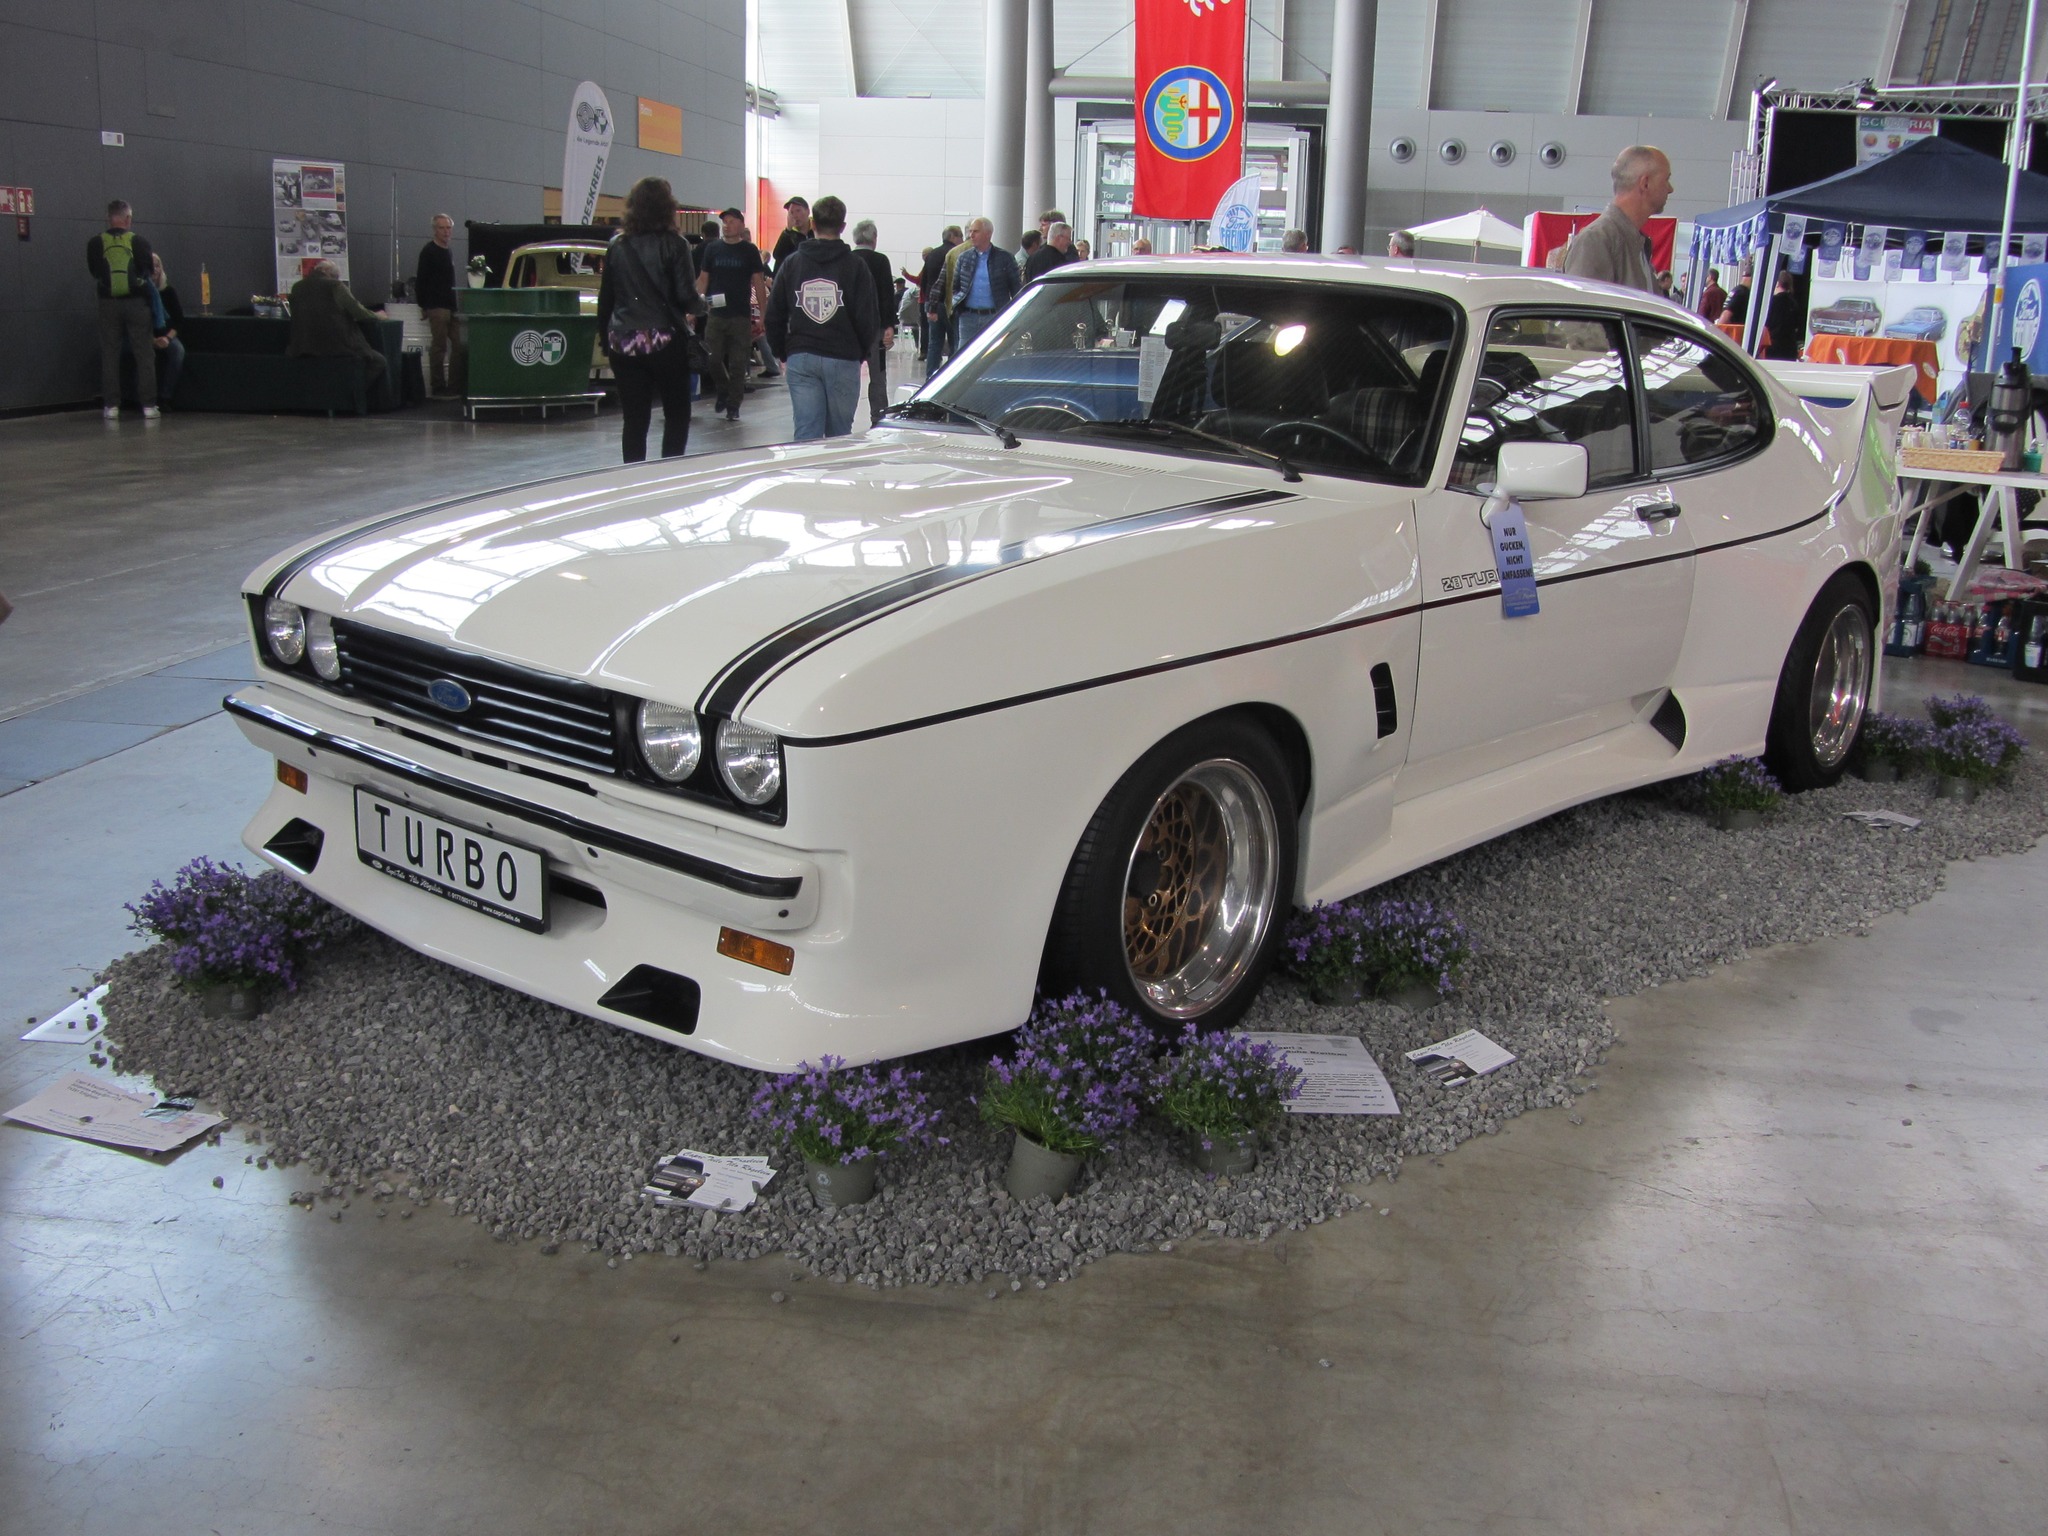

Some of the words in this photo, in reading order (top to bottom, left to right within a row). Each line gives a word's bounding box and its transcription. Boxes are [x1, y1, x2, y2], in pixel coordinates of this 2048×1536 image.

[1101, 191, 1114, 199] Tor
[1226, 216, 1250, 230] Ford
[1503, 527, 1517, 537] NUR
[1500, 540, 1526, 552] GUCKEN,
[1506, 555, 1524, 565] NICHT
[1502, 568, 1534, 580] ANFASSEN!
[374, 803, 518, 902] TURBO
